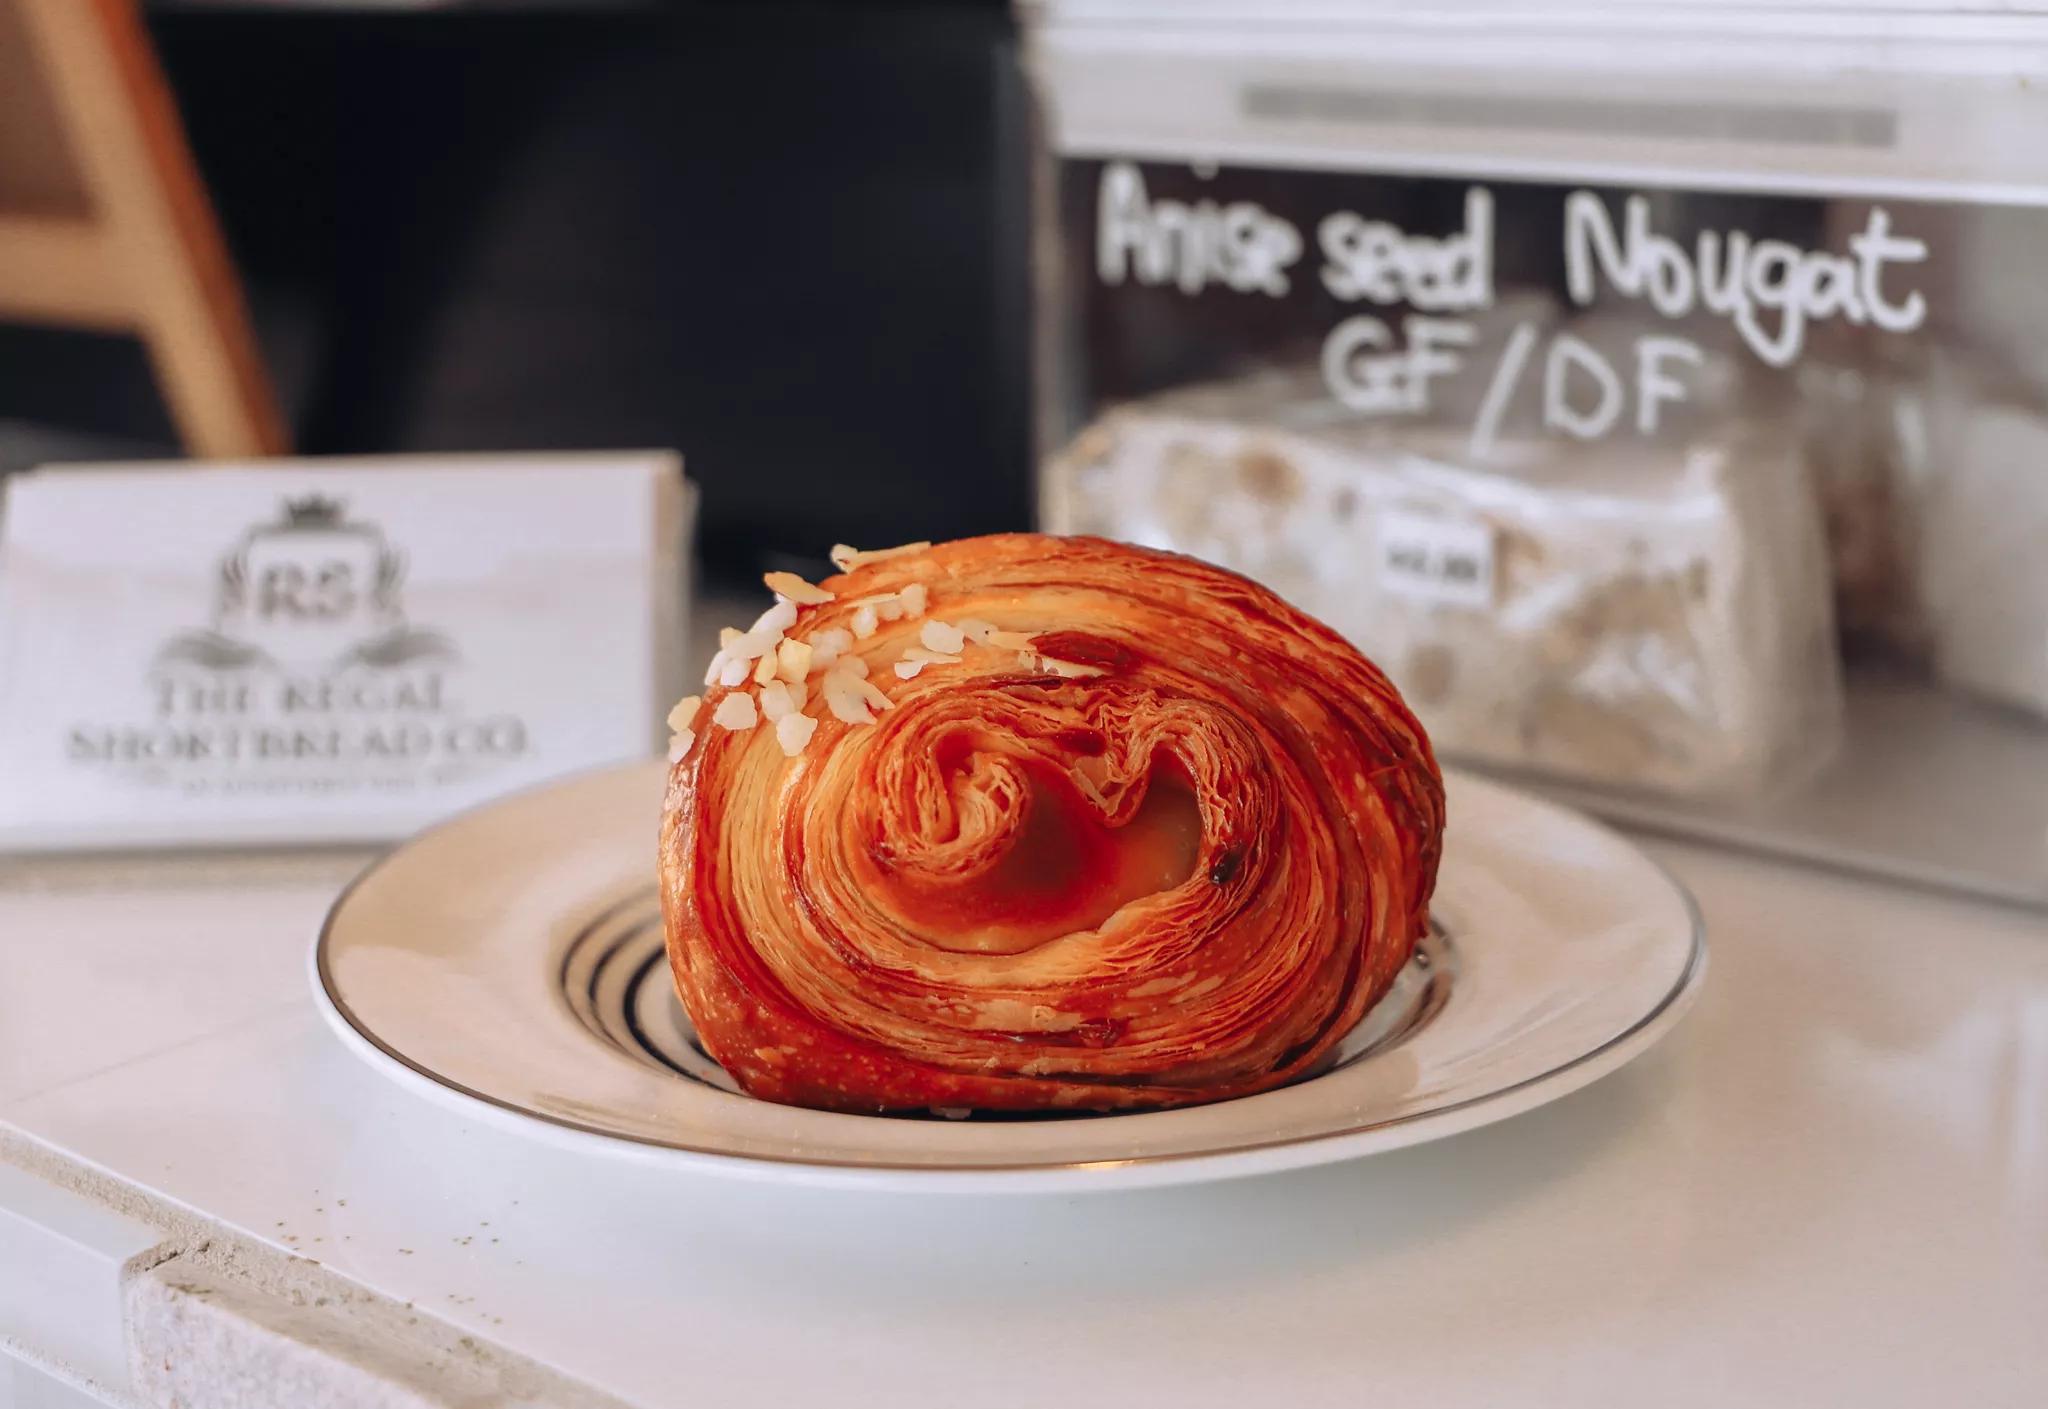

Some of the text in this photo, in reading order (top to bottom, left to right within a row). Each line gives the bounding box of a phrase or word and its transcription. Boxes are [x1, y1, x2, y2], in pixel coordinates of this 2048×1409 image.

[1098, 160, 1928, 366] Anise seed Nougat
[153, 671, 446, 716] THE REGAL
[66, 720, 434, 764] SHORTBREAD
